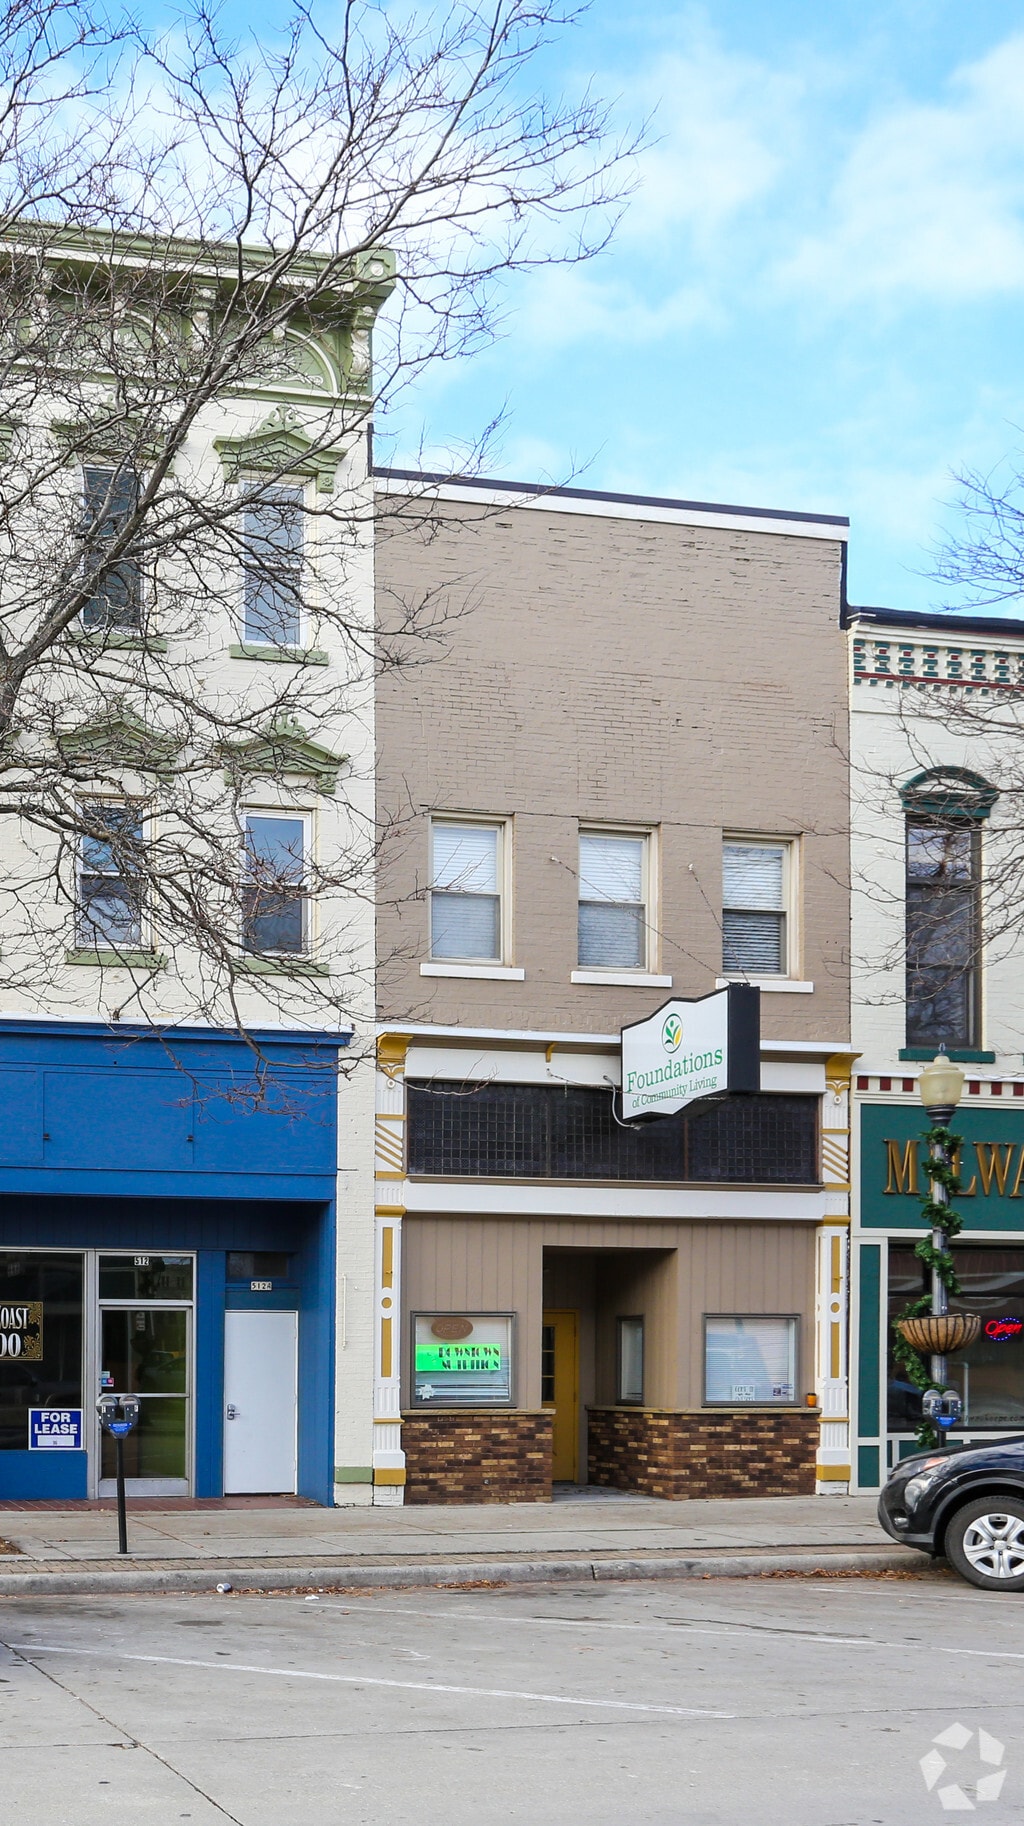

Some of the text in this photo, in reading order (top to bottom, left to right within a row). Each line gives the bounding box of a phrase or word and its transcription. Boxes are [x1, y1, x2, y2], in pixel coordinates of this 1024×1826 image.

[626, 1048, 723, 1093] Foundations
[632, 1076, 717, 1108] of Community Living
[134, 1256, 150, 1266] 512
[251, 1282, 272, 1291] 512A
[985, 1320, 1023, 1338] Open
[41, 1412, 71, 1423] FOR
[34, 1423, 78, 1434] LEASE
